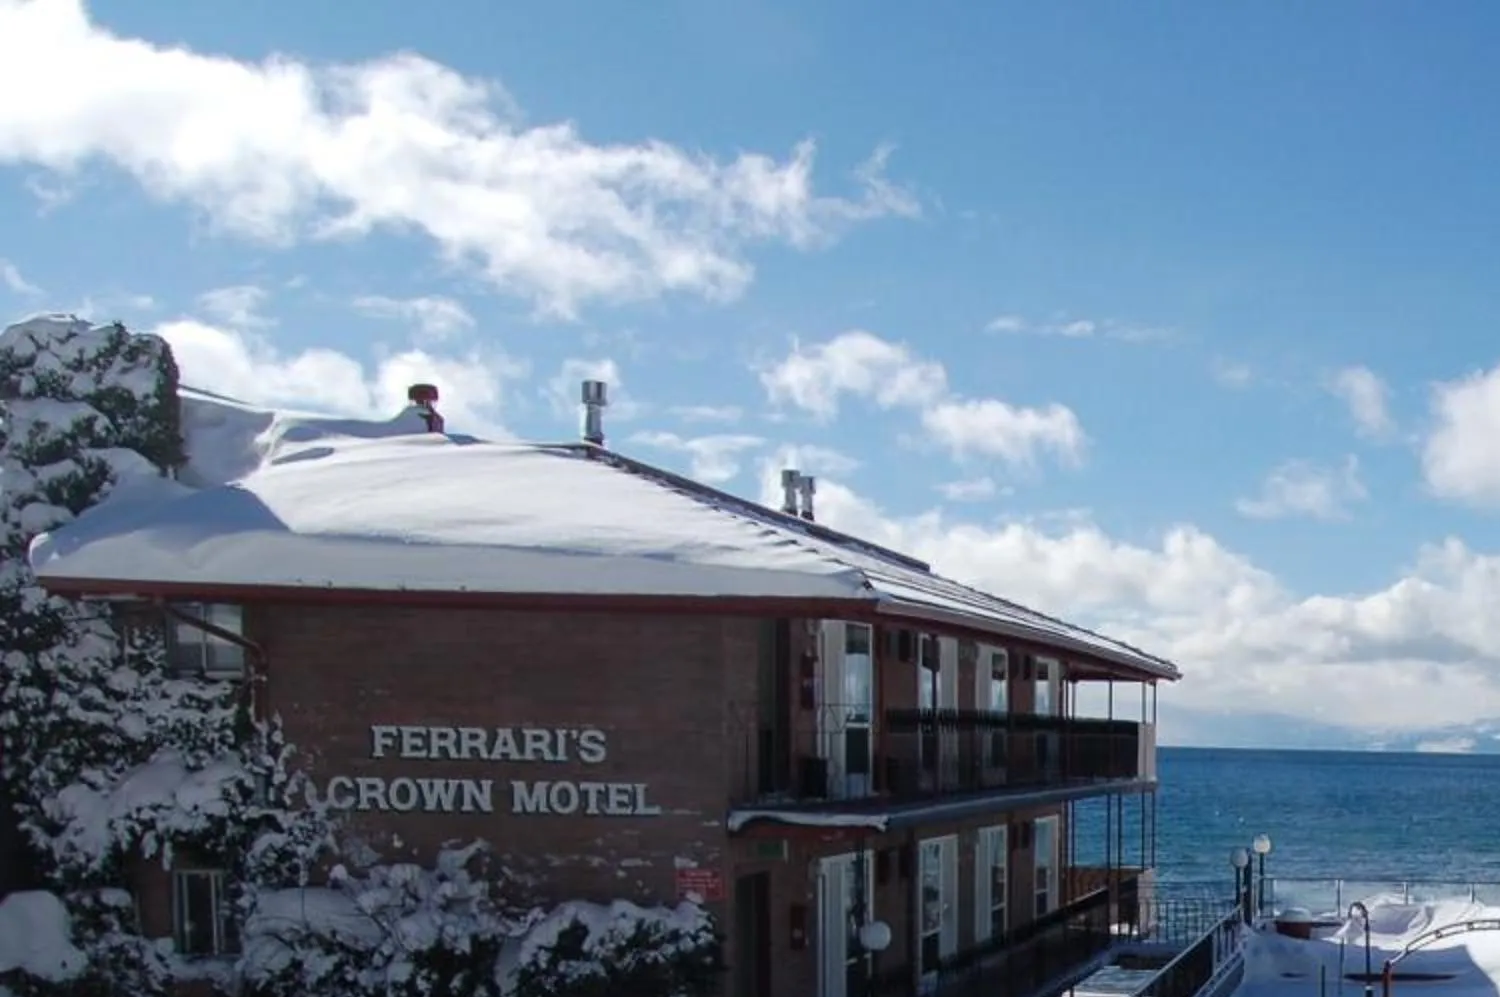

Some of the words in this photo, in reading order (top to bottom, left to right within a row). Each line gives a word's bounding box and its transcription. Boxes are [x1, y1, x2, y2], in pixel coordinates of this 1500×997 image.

[371, 724, 607, 763] FERRARI'S
[327, 775, 493, 813] CROWN
[511, 780, 662, 815] MOTEL
